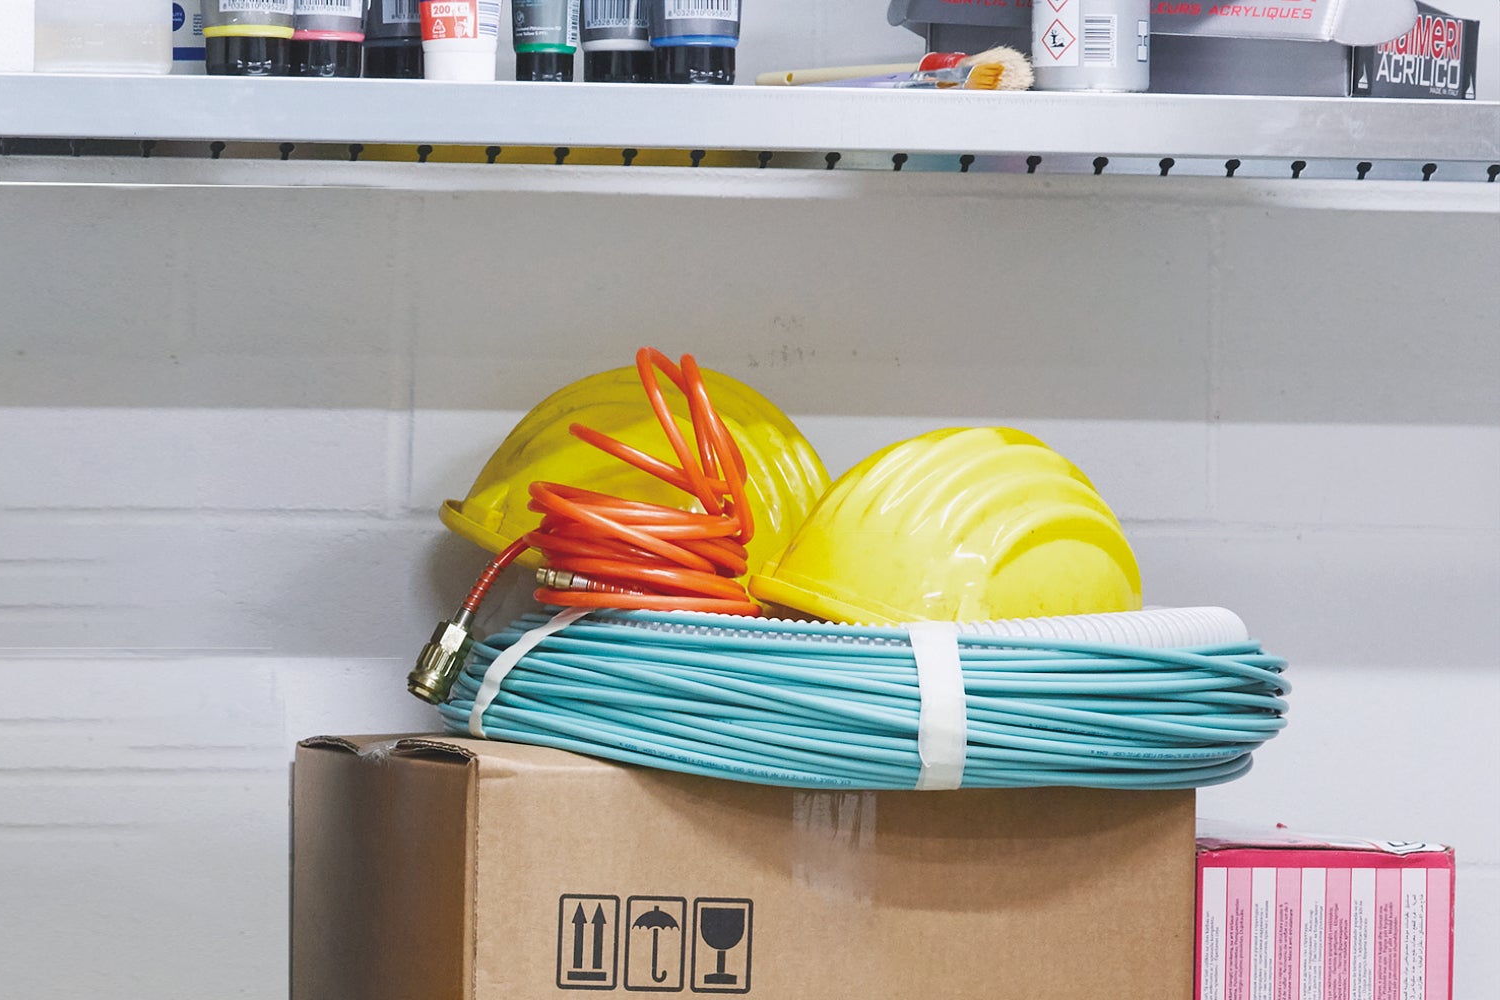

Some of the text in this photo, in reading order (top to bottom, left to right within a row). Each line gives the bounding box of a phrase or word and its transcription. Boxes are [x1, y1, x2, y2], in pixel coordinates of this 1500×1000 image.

[433, 5, 450, 14] 200
[1208, 4, 1313, 20] ACRYLIQUES
[1376, 53, 1461, 90] ACRILICO
